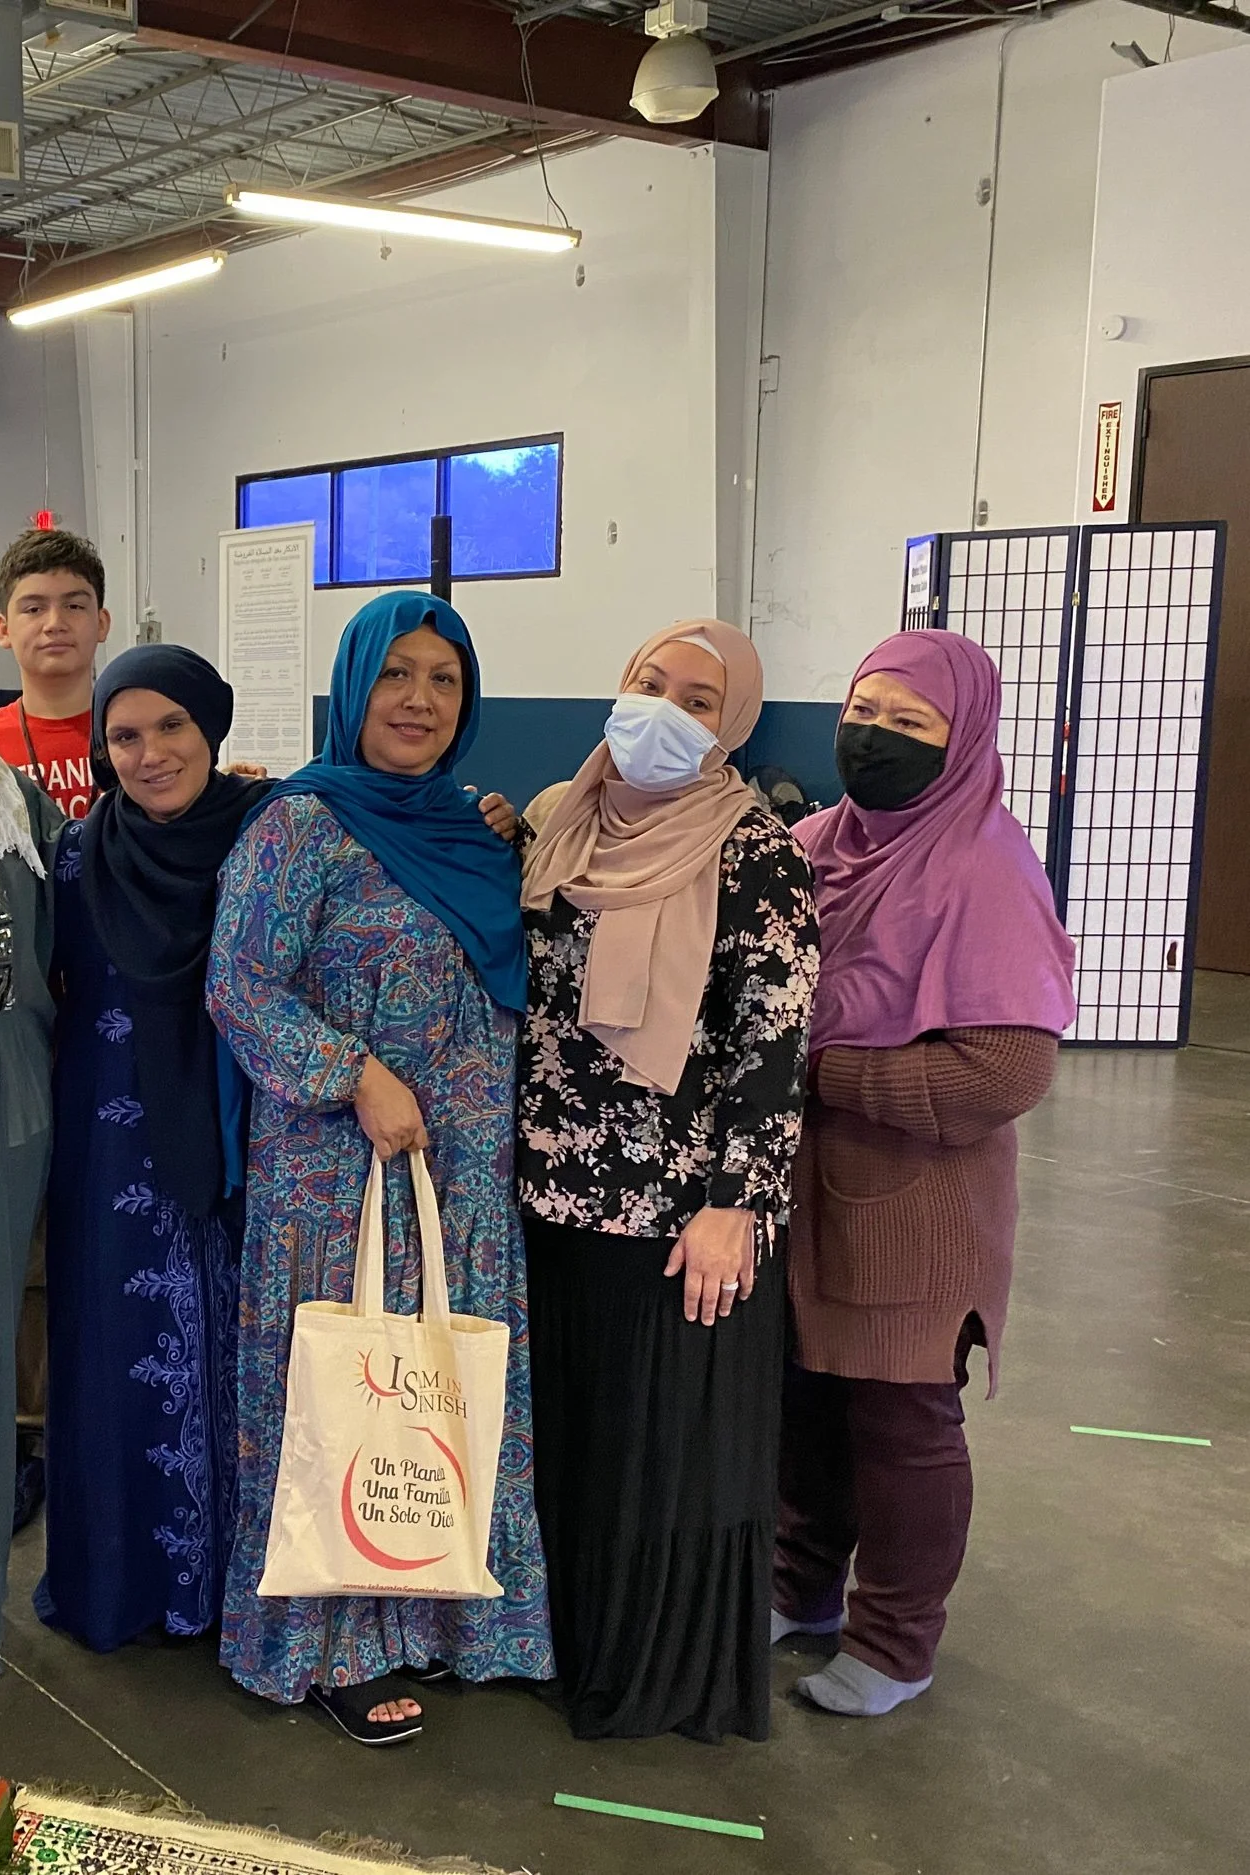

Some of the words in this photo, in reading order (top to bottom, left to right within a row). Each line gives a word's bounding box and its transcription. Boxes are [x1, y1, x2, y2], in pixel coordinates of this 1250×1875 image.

[1101, 409, 1119, 420] FIRE
[1101, 421, 1112, 501] EXTINGUISHER
[370, 1457, 396, 1477] Un
[362, 1479, 399, 1500] Una
[358, 1502, 385, 1522] Un
[389, 1505, 421, 1524] Solo
